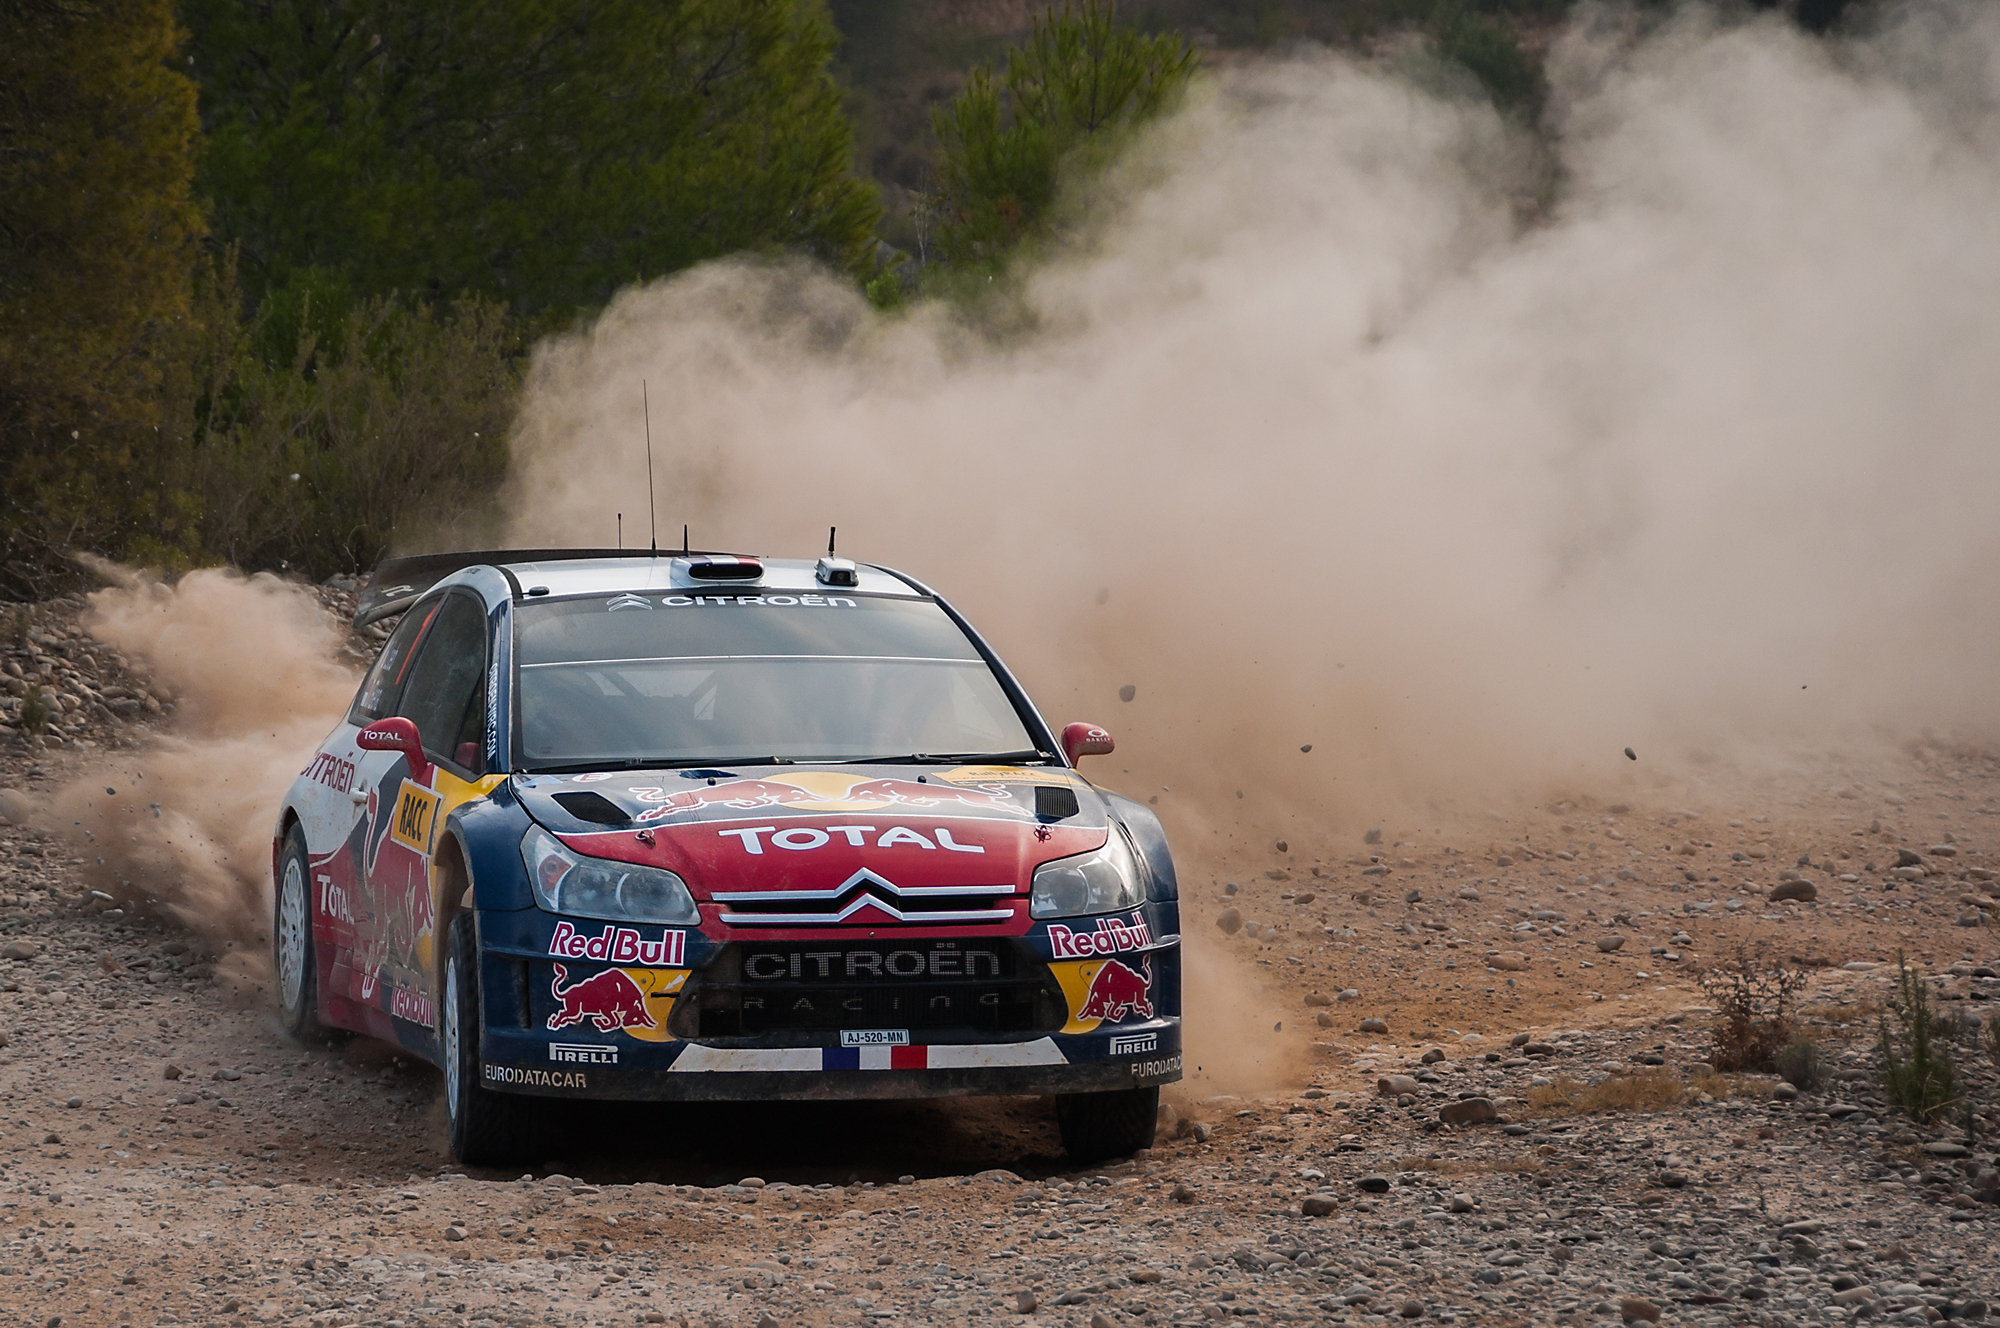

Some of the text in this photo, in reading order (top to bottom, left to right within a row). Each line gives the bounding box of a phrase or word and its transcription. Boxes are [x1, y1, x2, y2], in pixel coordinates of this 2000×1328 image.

[363, 730, 402, 741] TOTAL
[399, 793, 428, 842] RACC
[718, 825, 985, 854] TOTAL
[317, 874, 355, 926] TOTAL
[548, 920, 687, 966] Red Bull
[1047, 911, 1152, 959] Red Bull
[847, 1031, 903, 1043] AJ-520-MN
[1109, 1032, 1157, 1055] PIRELLI
[549, 1042, 618, 1064] PIRELLI
[485, 1064, 587, 1088] EURODATACAR
